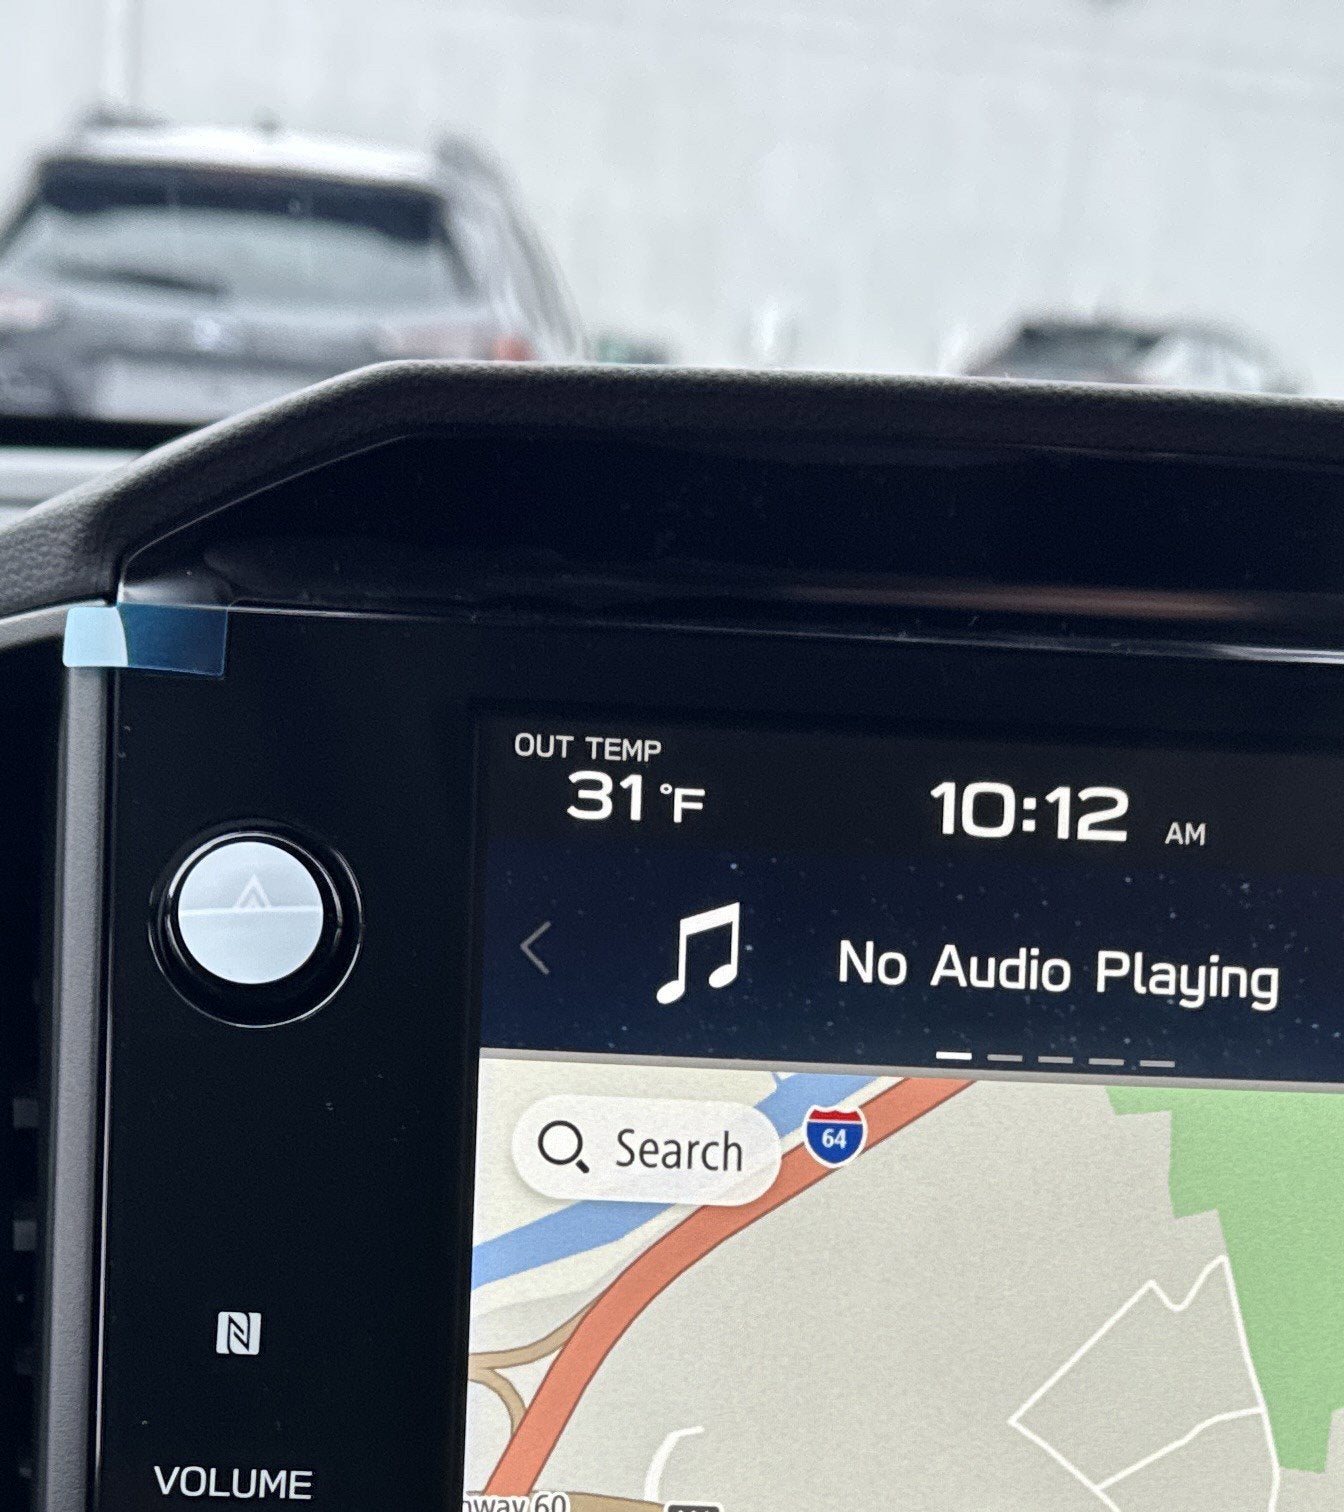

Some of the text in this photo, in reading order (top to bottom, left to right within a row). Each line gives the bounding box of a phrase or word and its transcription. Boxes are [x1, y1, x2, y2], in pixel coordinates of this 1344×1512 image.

[514, 732, 662, 763] OUT TEMP
[930, 781, 1206, 847] 10:12 AM
[839, 939, 1280, 1012] No Audio Playing
[615, 1128, 743, 1172] Search
[822, 1128, 847, 1148] 64
[153, 1465, 314, 1500] VOLUME
